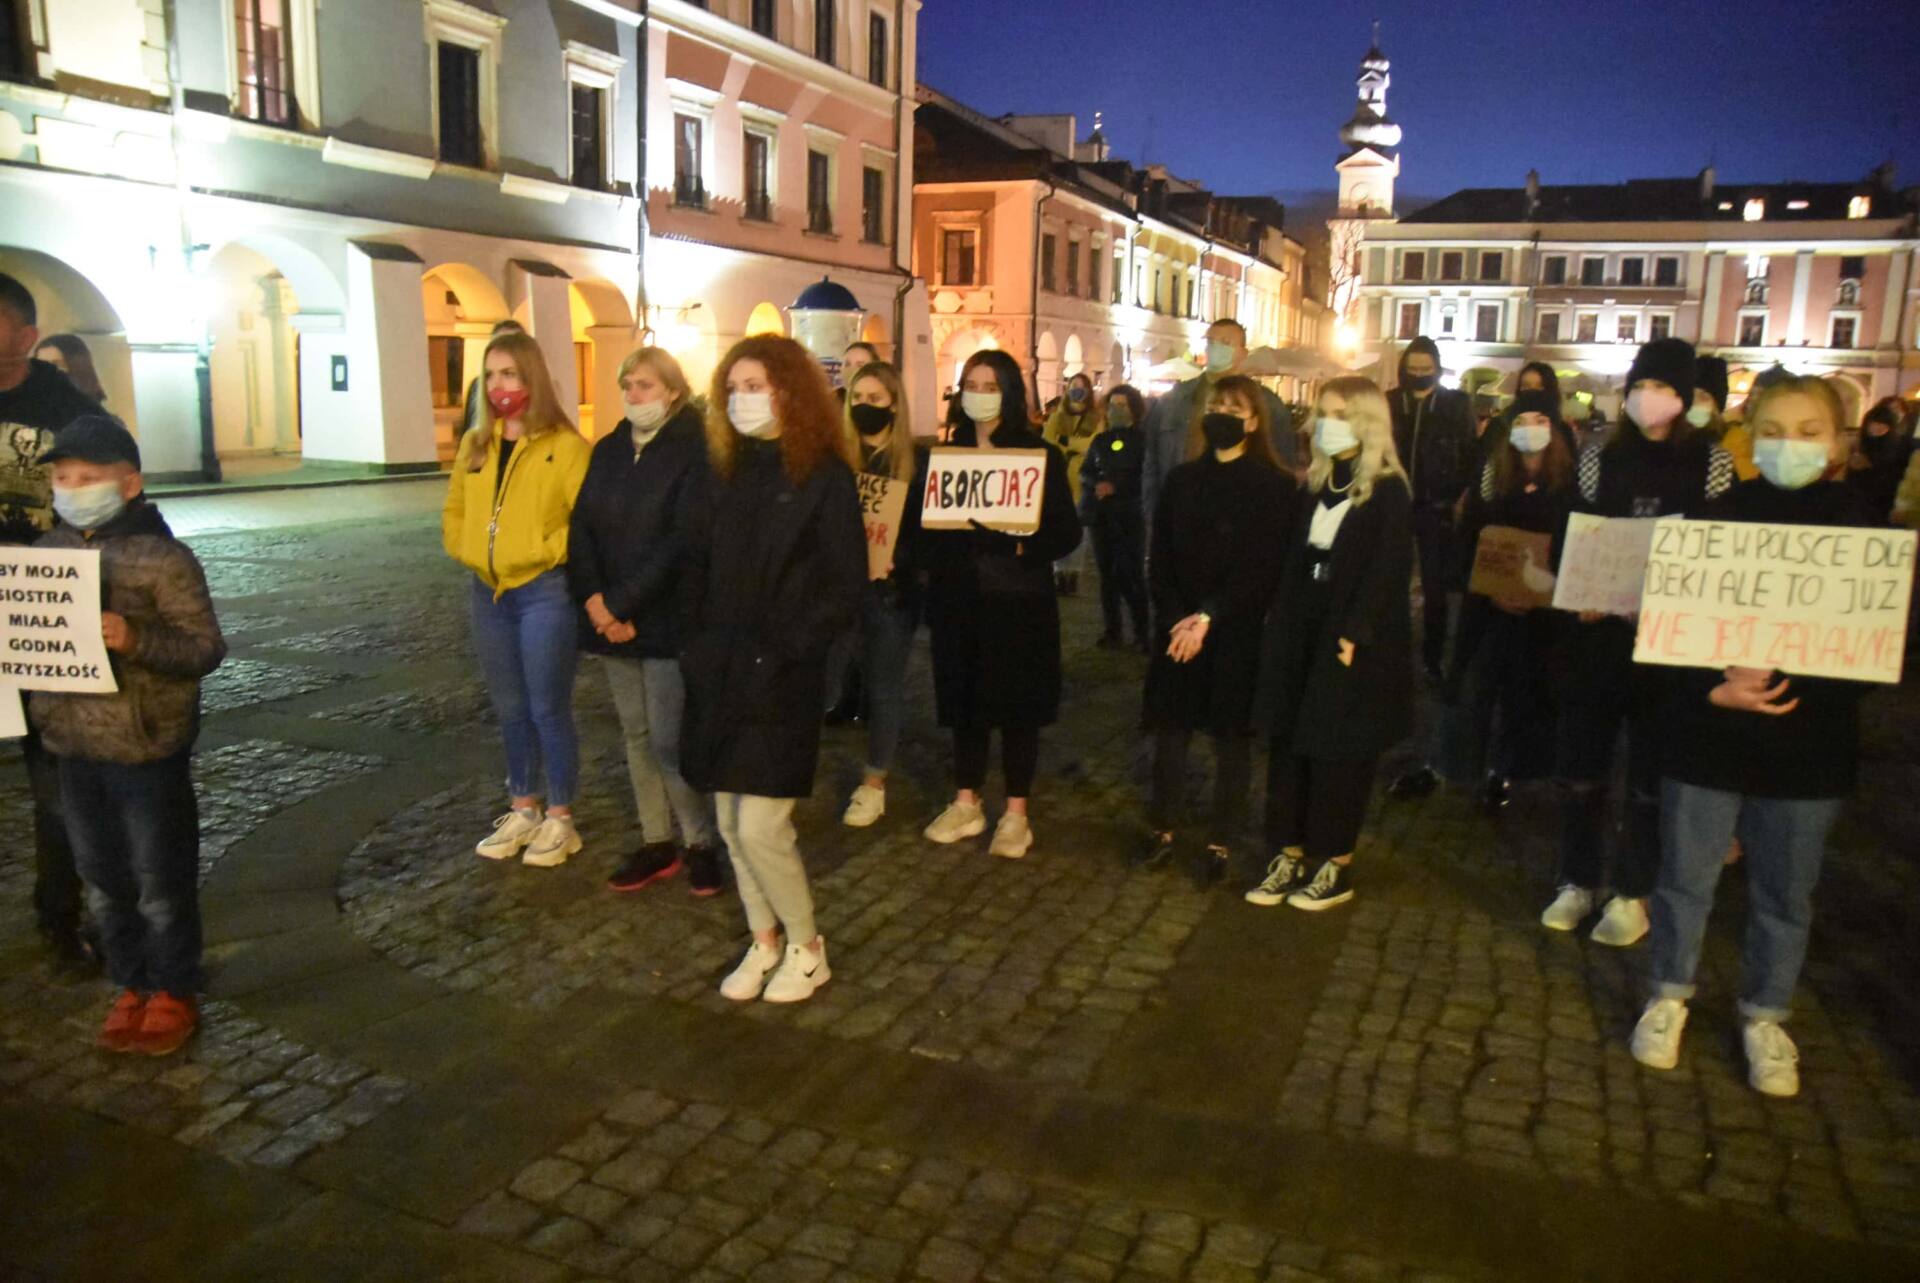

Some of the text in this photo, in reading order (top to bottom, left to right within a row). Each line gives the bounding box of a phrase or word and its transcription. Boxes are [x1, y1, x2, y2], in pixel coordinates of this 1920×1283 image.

[924, 467, 1040, 509] ABORCJA?
[1733, 527, 1750, 559] W
[1756, 527, 1853, 567] POLSCE
[1863, 536, 1914, 571] DLA
[26, 565, 79, 579] MOJA
[1645, 560, 1708, 599] BEKI
[1717, 569, 1773, 608] ALE
[1786, 573, 1825, 607] TO
[9, 613, 69, 628] MIAŁA
[1637, 608, 1695, 657] NIE
[1703, 615, 1761, 662] JEST
[9, 638, 77, 656] GODNĄ
[1, 661, 101, 680] RZYSZŁOŚĆ
